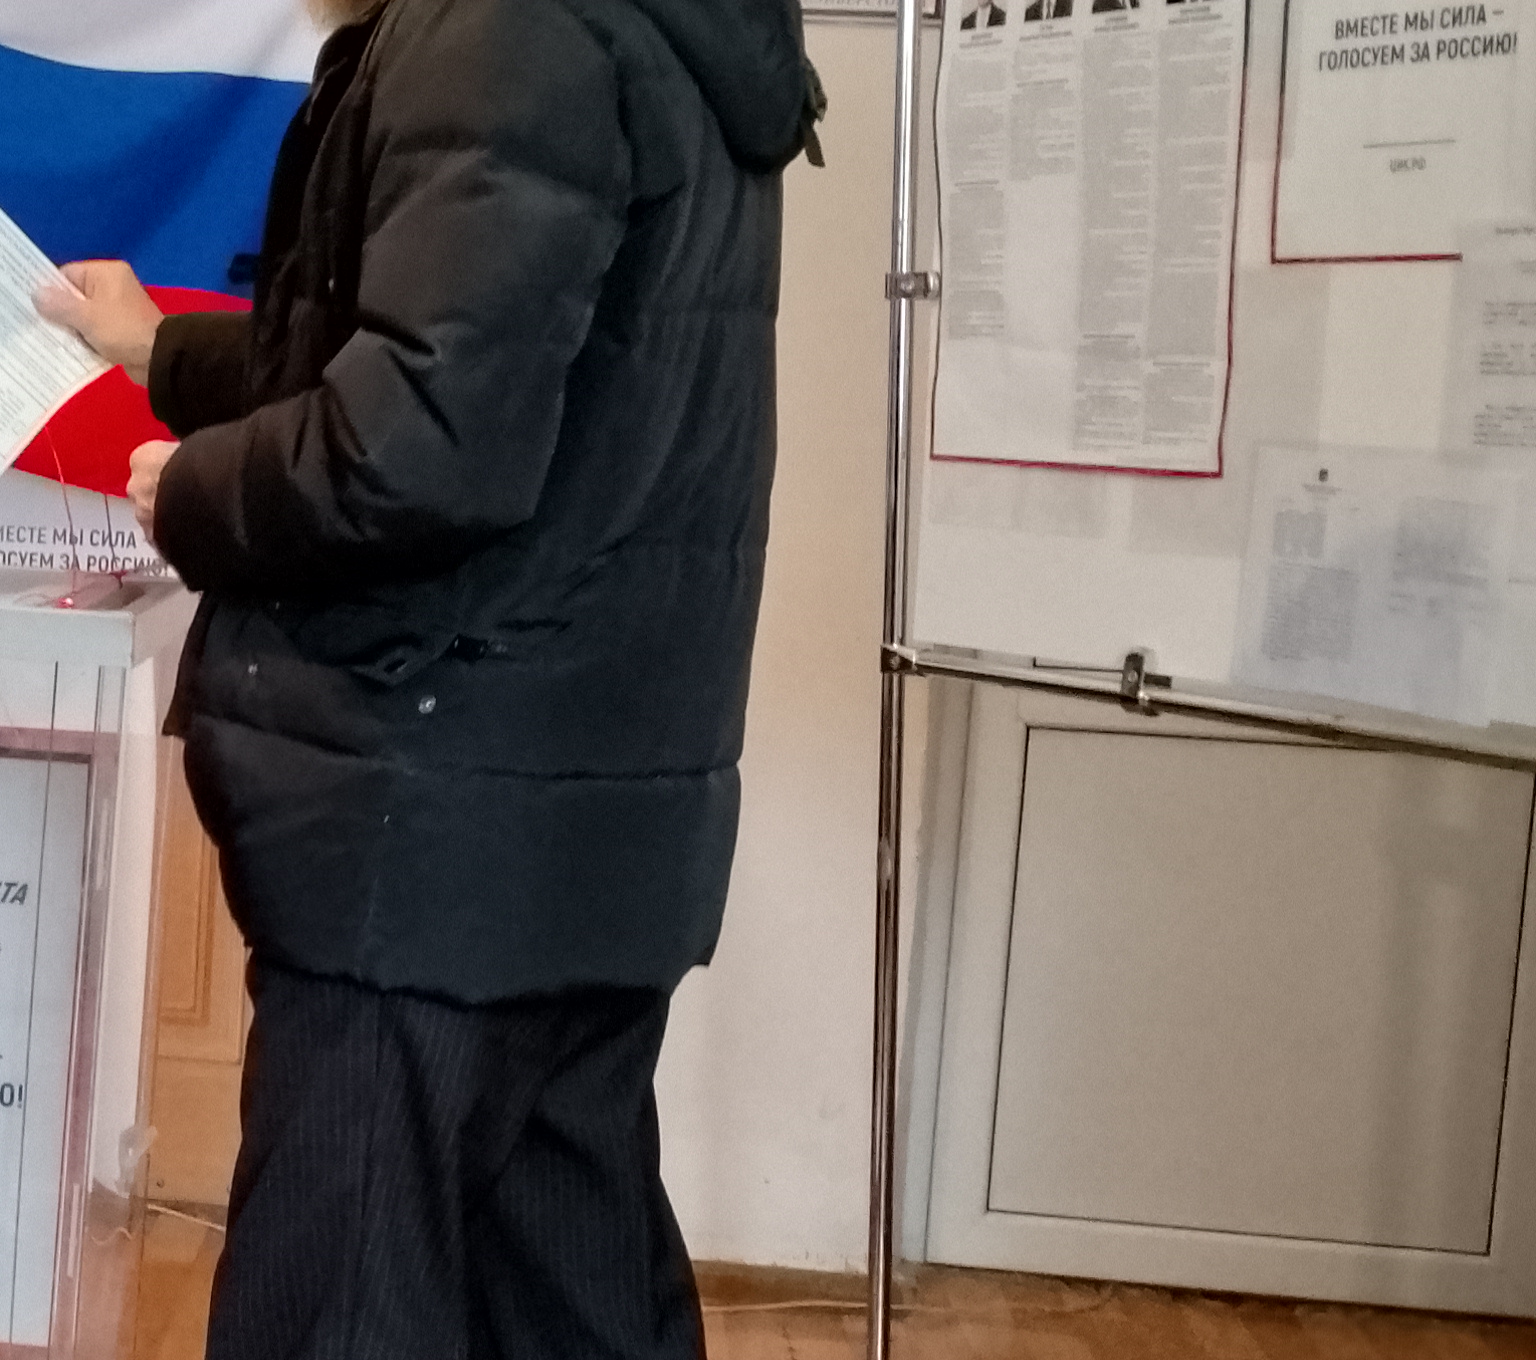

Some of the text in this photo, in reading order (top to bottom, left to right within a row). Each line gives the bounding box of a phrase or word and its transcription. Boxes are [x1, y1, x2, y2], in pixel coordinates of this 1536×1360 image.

[1334, 13, 1400, 40] ВМЕСТЕ
[1404, 9, 1435, 33] МЫ
[1440, 3, 1487, 30] СИЛА
[1319, 32, 1518, 72] ГОЛОСУЕМ ЗА РОССИЮ!
[52, 527, 84, 547] МЫ
[89, 528, 138, 549] СИЛА
